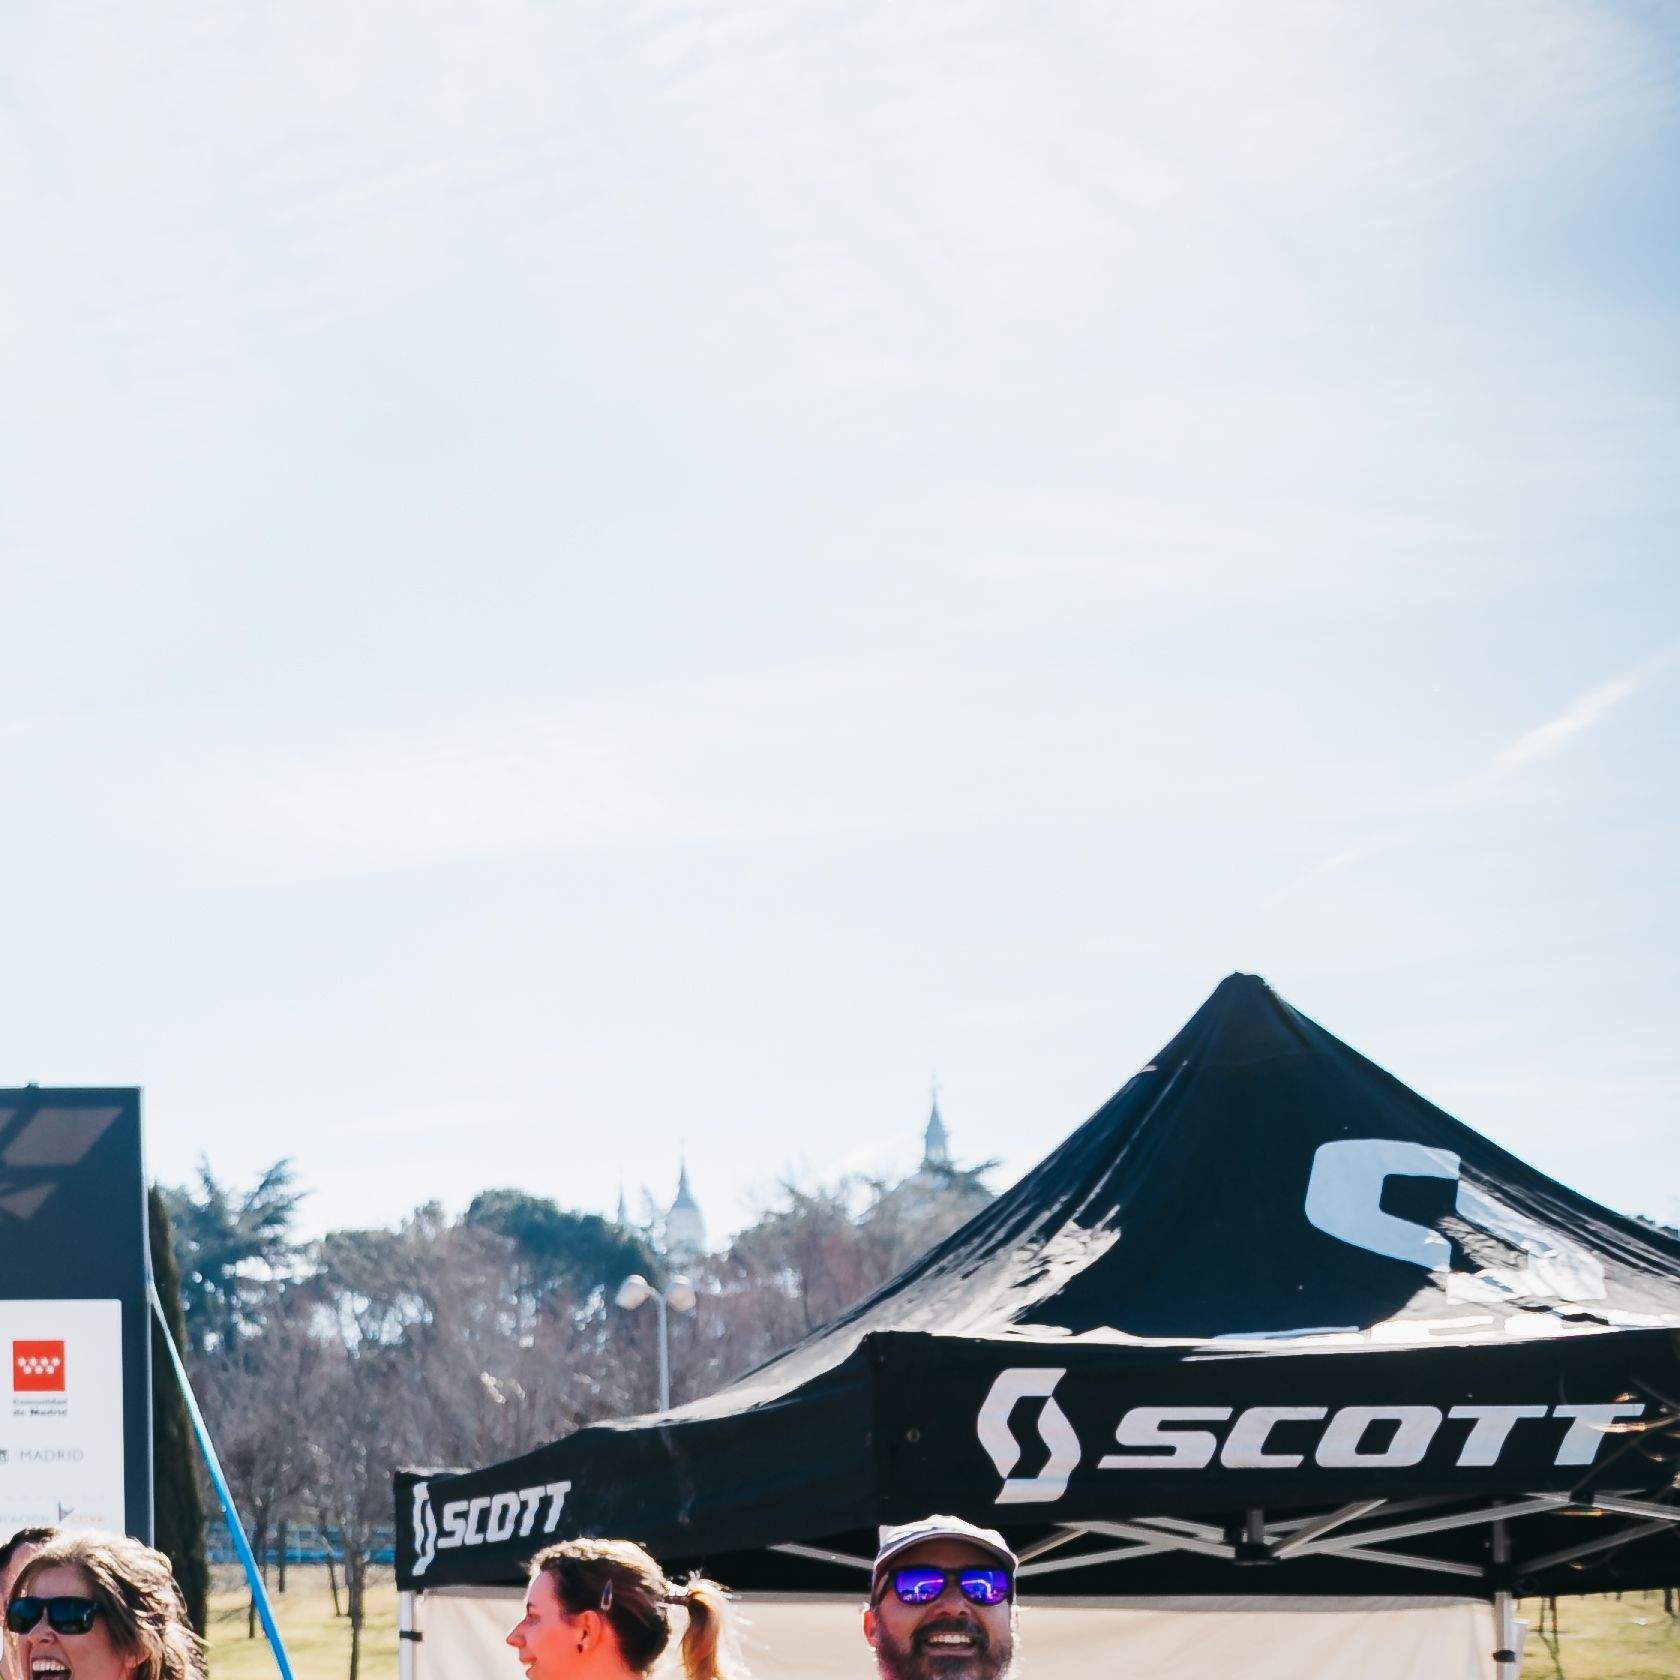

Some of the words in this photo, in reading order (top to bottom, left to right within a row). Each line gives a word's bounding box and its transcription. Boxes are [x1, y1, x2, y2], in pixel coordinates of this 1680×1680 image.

[19, 1448, 85, 1463] MADRID
[1097, 1403, 1646, 1469] SCOTT
[437, 1480, 572, 1549] SCOTT
